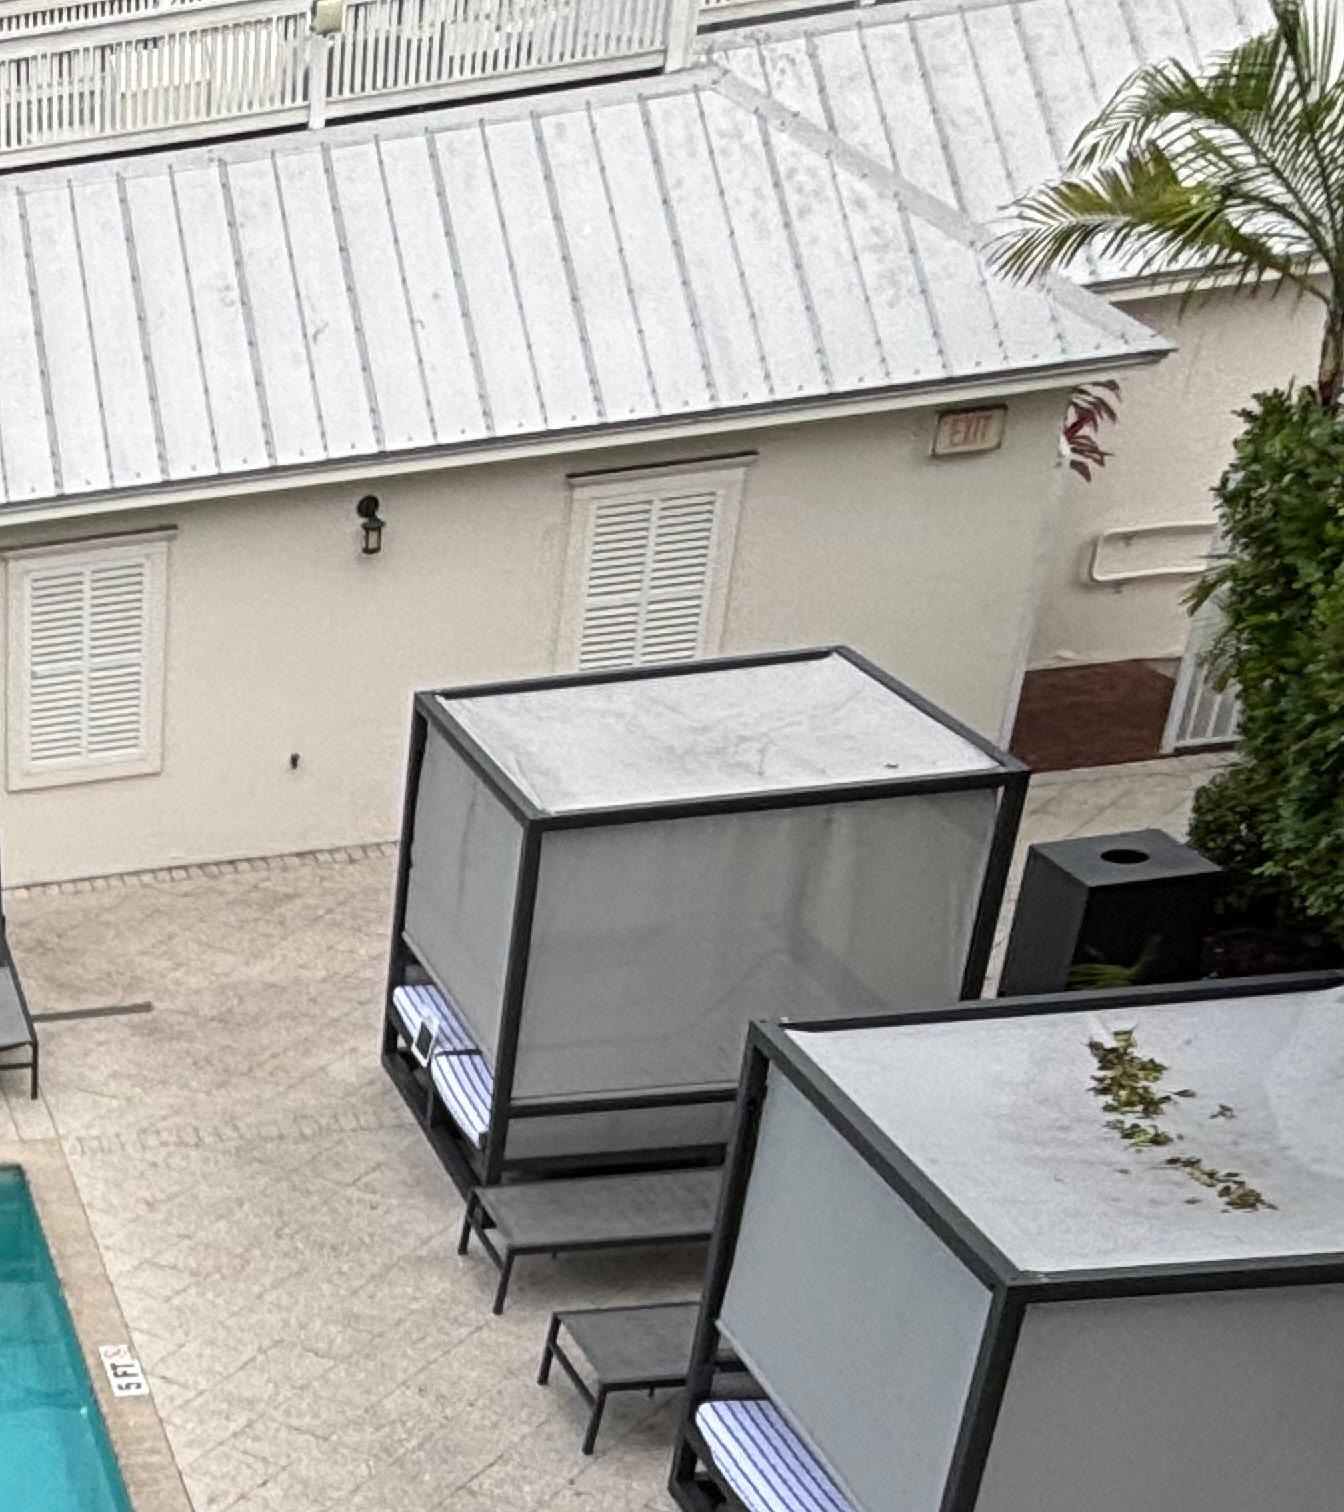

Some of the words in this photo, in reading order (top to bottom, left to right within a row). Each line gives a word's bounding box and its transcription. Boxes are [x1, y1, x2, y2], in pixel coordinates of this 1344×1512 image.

[949, 412, 993, 447] EXIT
[110, 1362, 140, 1378] FT
[117, 1382, 142, 1391] 5
